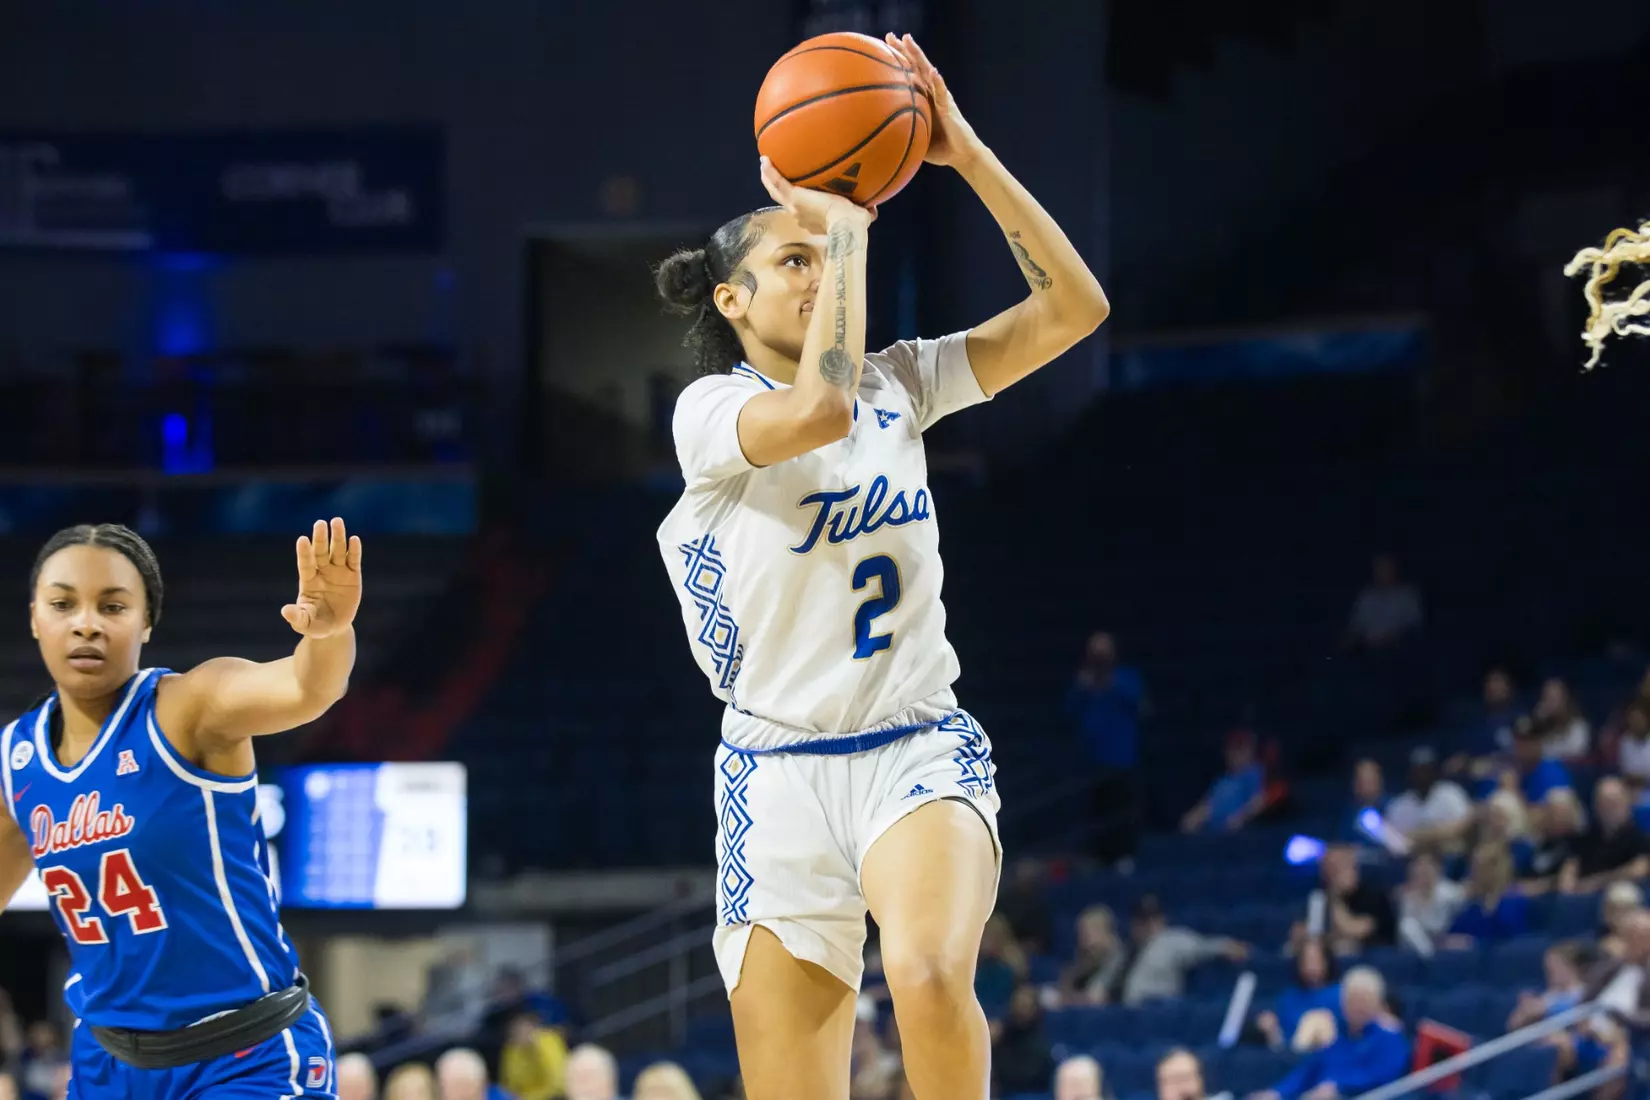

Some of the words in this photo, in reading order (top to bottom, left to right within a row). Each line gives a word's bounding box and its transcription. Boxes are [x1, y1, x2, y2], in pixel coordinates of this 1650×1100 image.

[789, 474, 930, 555] Tulsa
[850, 553, 903, 661] 2
[30, 790, 135, 860] Dallas
[41, 848, 169, 944] 24
